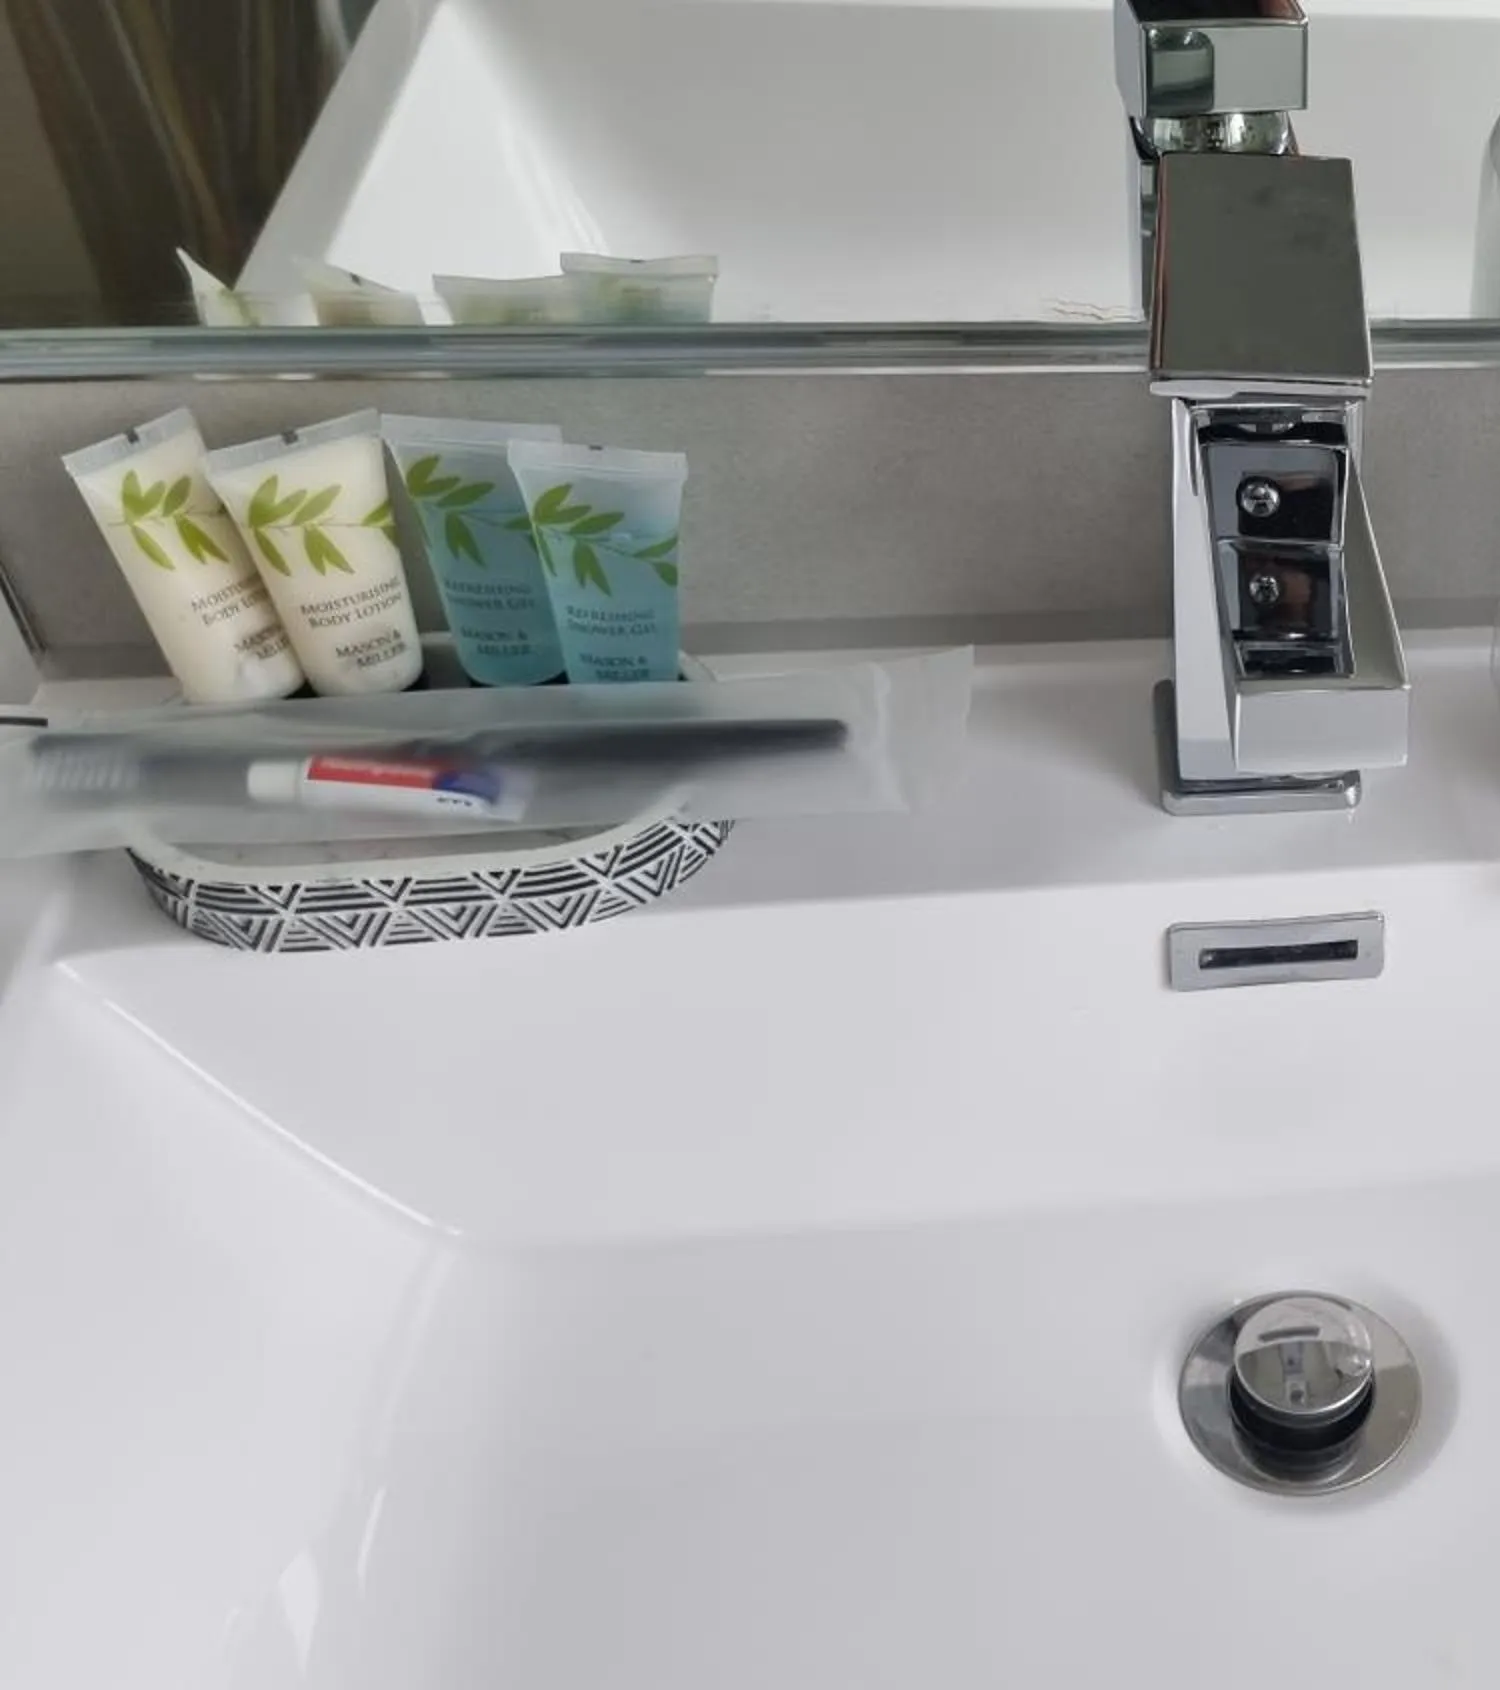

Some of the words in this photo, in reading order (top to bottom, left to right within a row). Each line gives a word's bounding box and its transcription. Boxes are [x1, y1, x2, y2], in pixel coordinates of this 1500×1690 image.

[300, 576, 402, 615] MOISTURISING
[308, 611, 351, 629] BODY
[354, 592, 402, 619] LOTION
[335, 635, 392, 659] MASON
